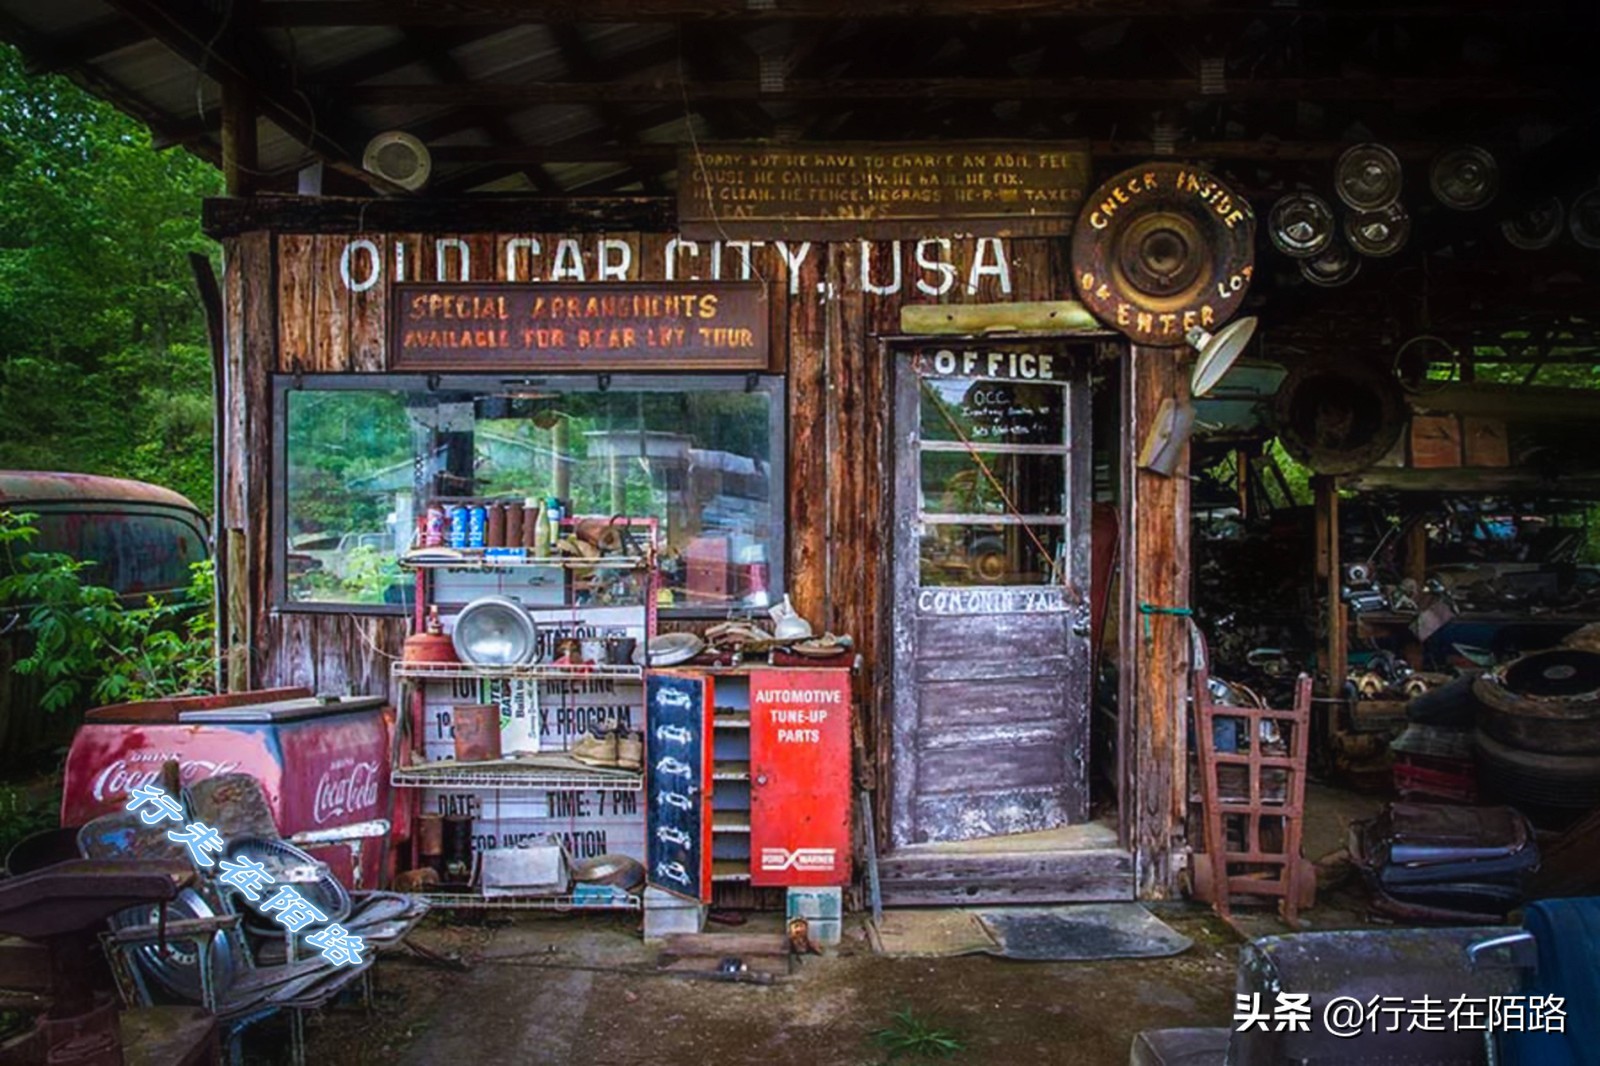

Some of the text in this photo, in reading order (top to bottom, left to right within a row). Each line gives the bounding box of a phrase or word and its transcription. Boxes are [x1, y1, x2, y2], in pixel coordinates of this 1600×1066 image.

[963, 155, 986, 168] AN
[1176, 170, 1244, 229] INSIDE
[340, 238, 470, 292] OLD
[506, 238, 632, 282] CAR
[861, 237, 1012, 297] USA
[408, 293, 510, 321] SPECIAL
[1116, 303, 1215, 334] ENTER
[402, 329, 511, 349] AVAILABLE
[524, 328, 566, 348] FOR
[576, 327, 637, 349] REAR
[698, 327, 754, 348] TOUR
[934, 350, 1053, 379] OFFICE
[755, 689, 842, 704] AUTOMOTIVE
[556, 704, 632, 736] PROGRAM
[770, 709, 828, 723] TUNE-UP
[777, 729, 820, 744] PARTS
[437, 790, 638, 821] DATE: TIME: 7 PM
